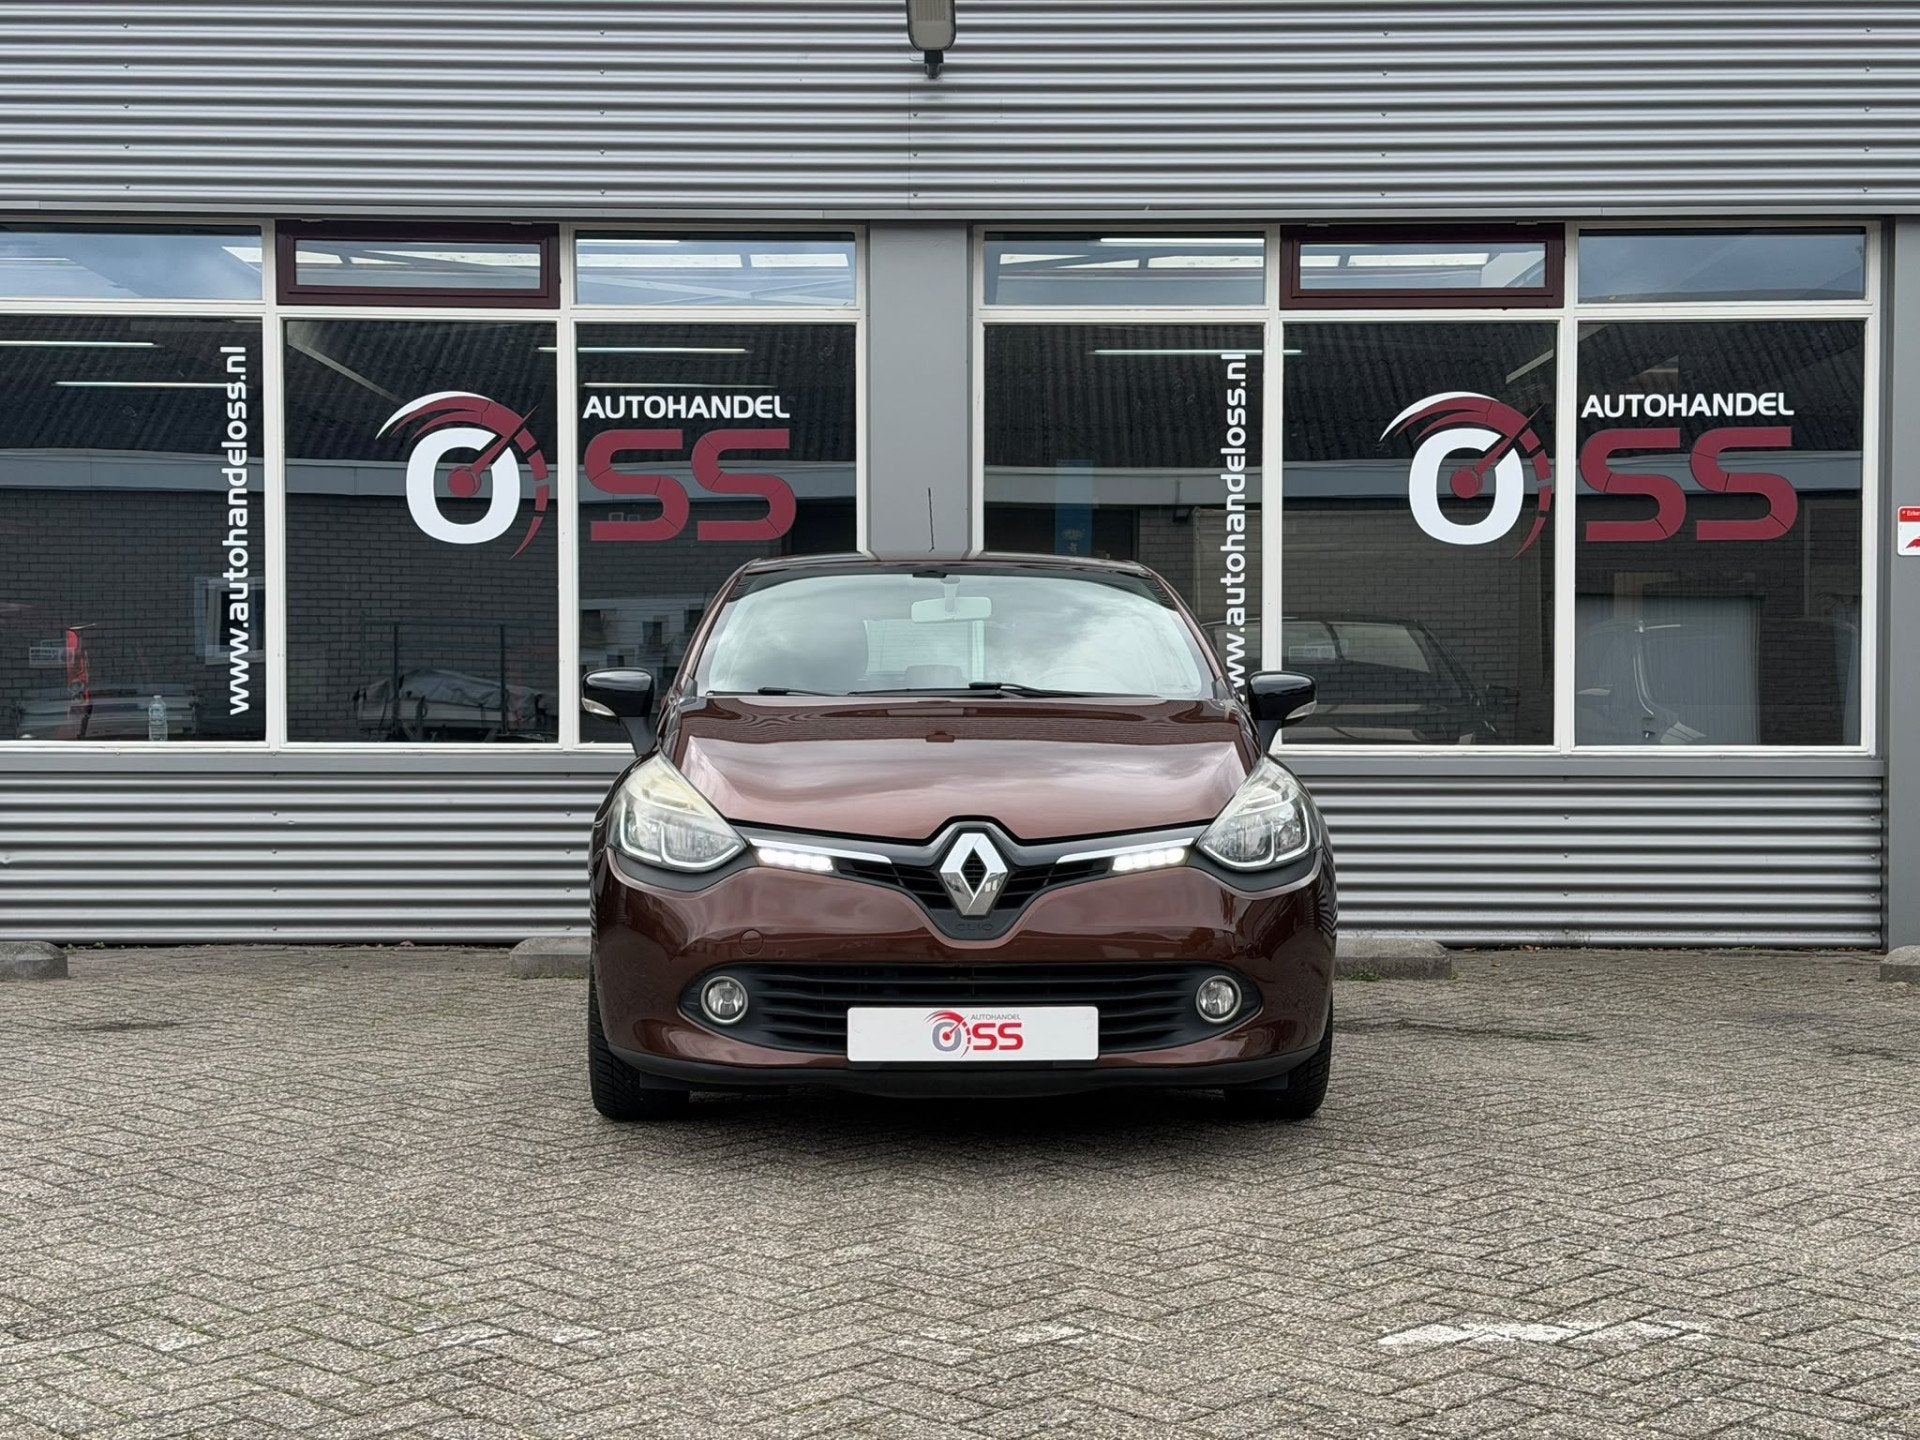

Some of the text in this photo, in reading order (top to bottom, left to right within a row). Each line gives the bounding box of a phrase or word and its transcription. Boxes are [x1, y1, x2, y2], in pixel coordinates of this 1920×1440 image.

[582, 395, 790, 419] AUTOHANDEL
[1581, 392, 1794, 418] AUTOHANDEL
[219, 346, 249, 715] www.autohandeloss.nl
[1220, 353, 1246, 702] ww.autohandeloss.nl
[932, 1021, 1024, 1052] OSS
